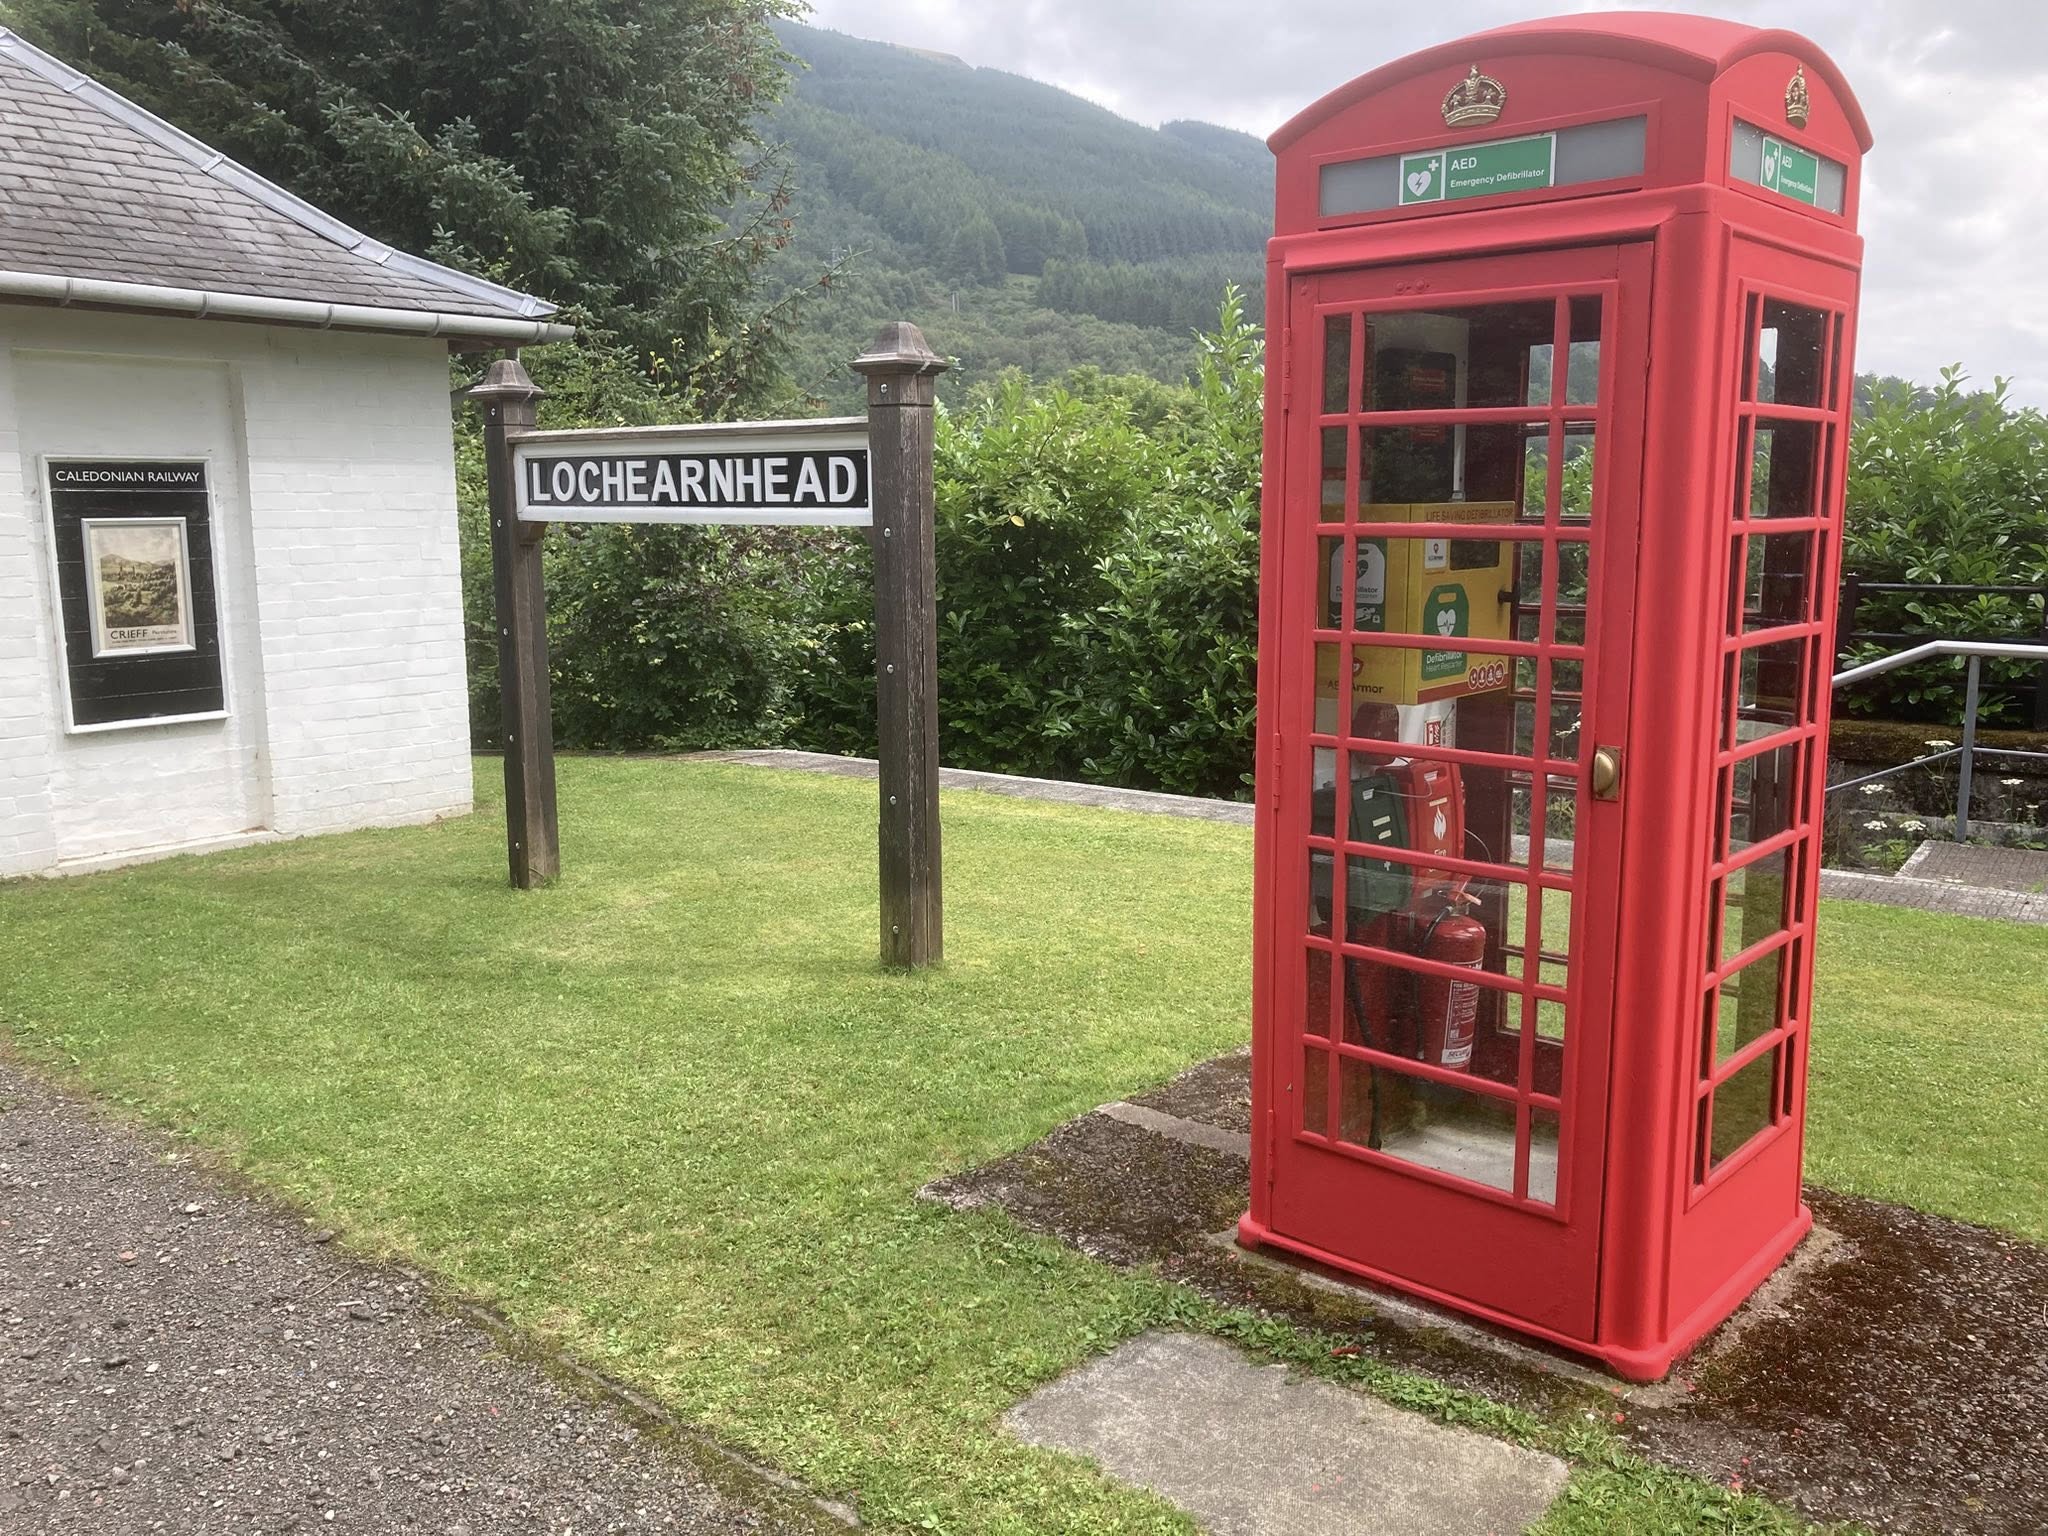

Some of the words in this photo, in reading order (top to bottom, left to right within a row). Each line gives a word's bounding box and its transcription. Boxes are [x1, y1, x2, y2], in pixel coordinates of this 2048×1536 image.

[1450, 156, 1478, 172] AED
[1781, 155, 1792, 168] AED
[1450, 174, 1495, 189] Emergency
[1496, 168, 1545, 183] Defibrillator
[55, 470, 145, 483] CALEDONIAN
[147, 471, 200, 483] RAILWAY
[531, 456, 858, 504] LOCHEARNHEAD
[1425, 511, 1440, 522] LIFE
[1441, 510, 1465, 521] SAVING
[1465, 507, 1514, 520] DEFIBRILLATOR
[110, 628, 148, 640] CRIEFF
